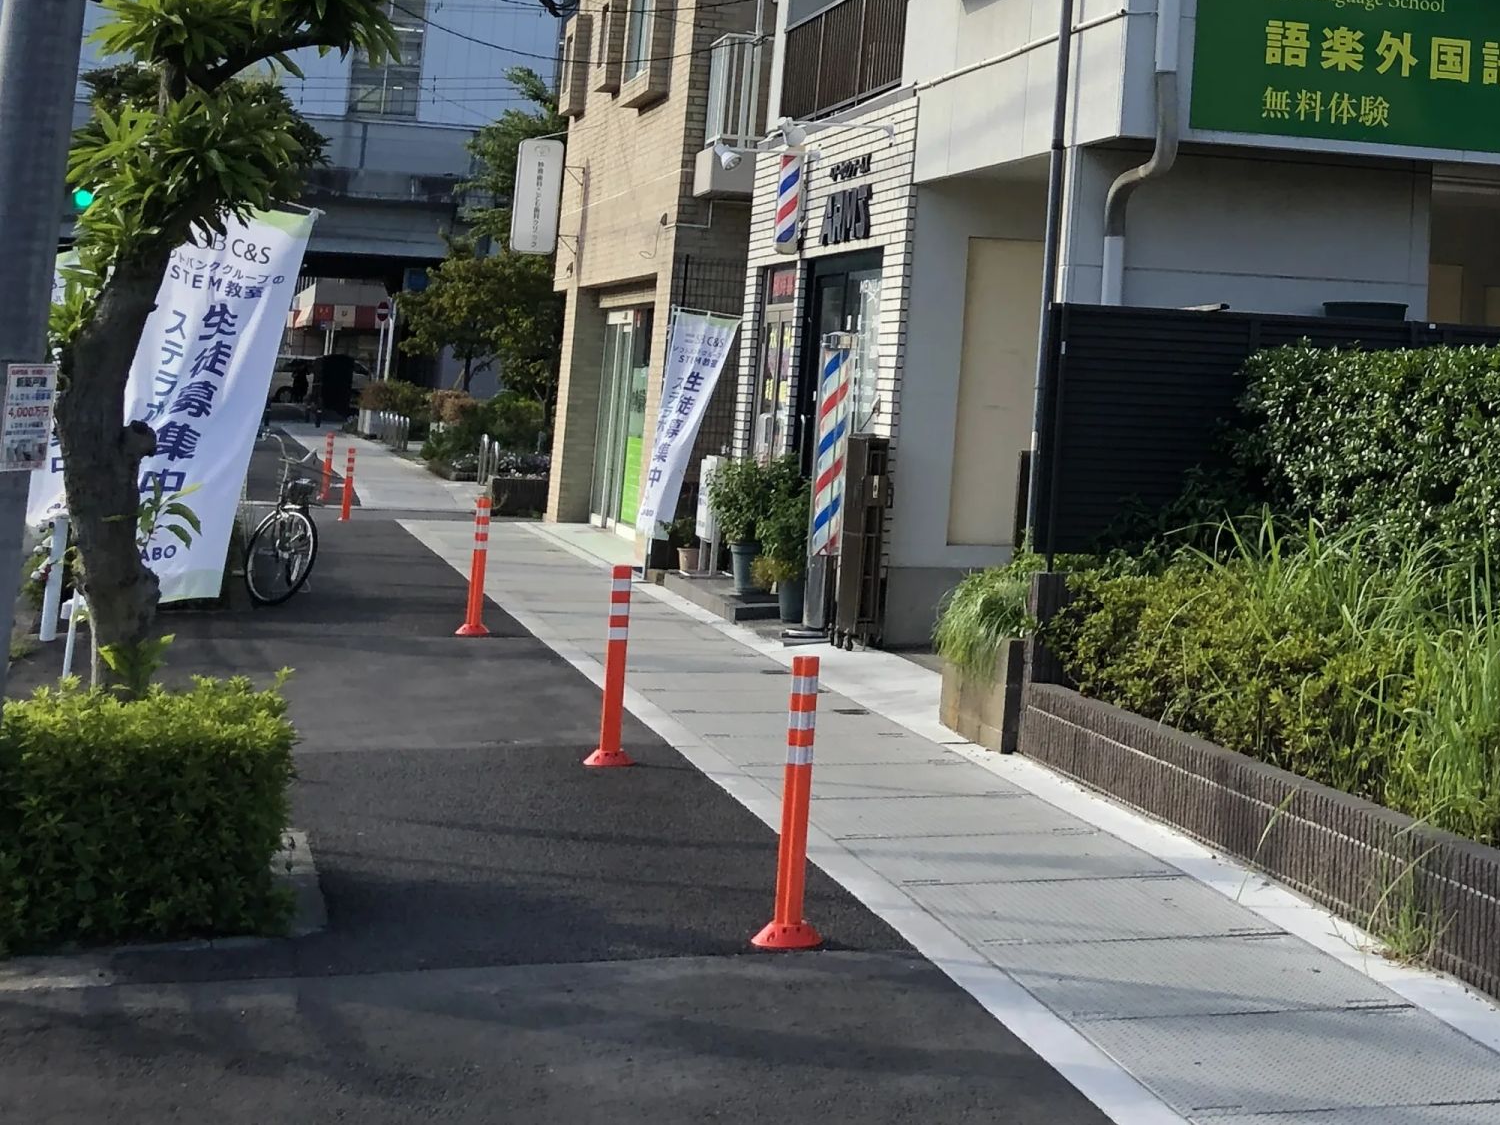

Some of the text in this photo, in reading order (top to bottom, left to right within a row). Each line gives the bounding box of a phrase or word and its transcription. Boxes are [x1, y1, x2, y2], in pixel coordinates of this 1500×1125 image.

[1261, 86, 1391, 128] 無料体験
[232, 238, 272, 265] C&S
[139, 303, 239, 499] 生徒募集中
